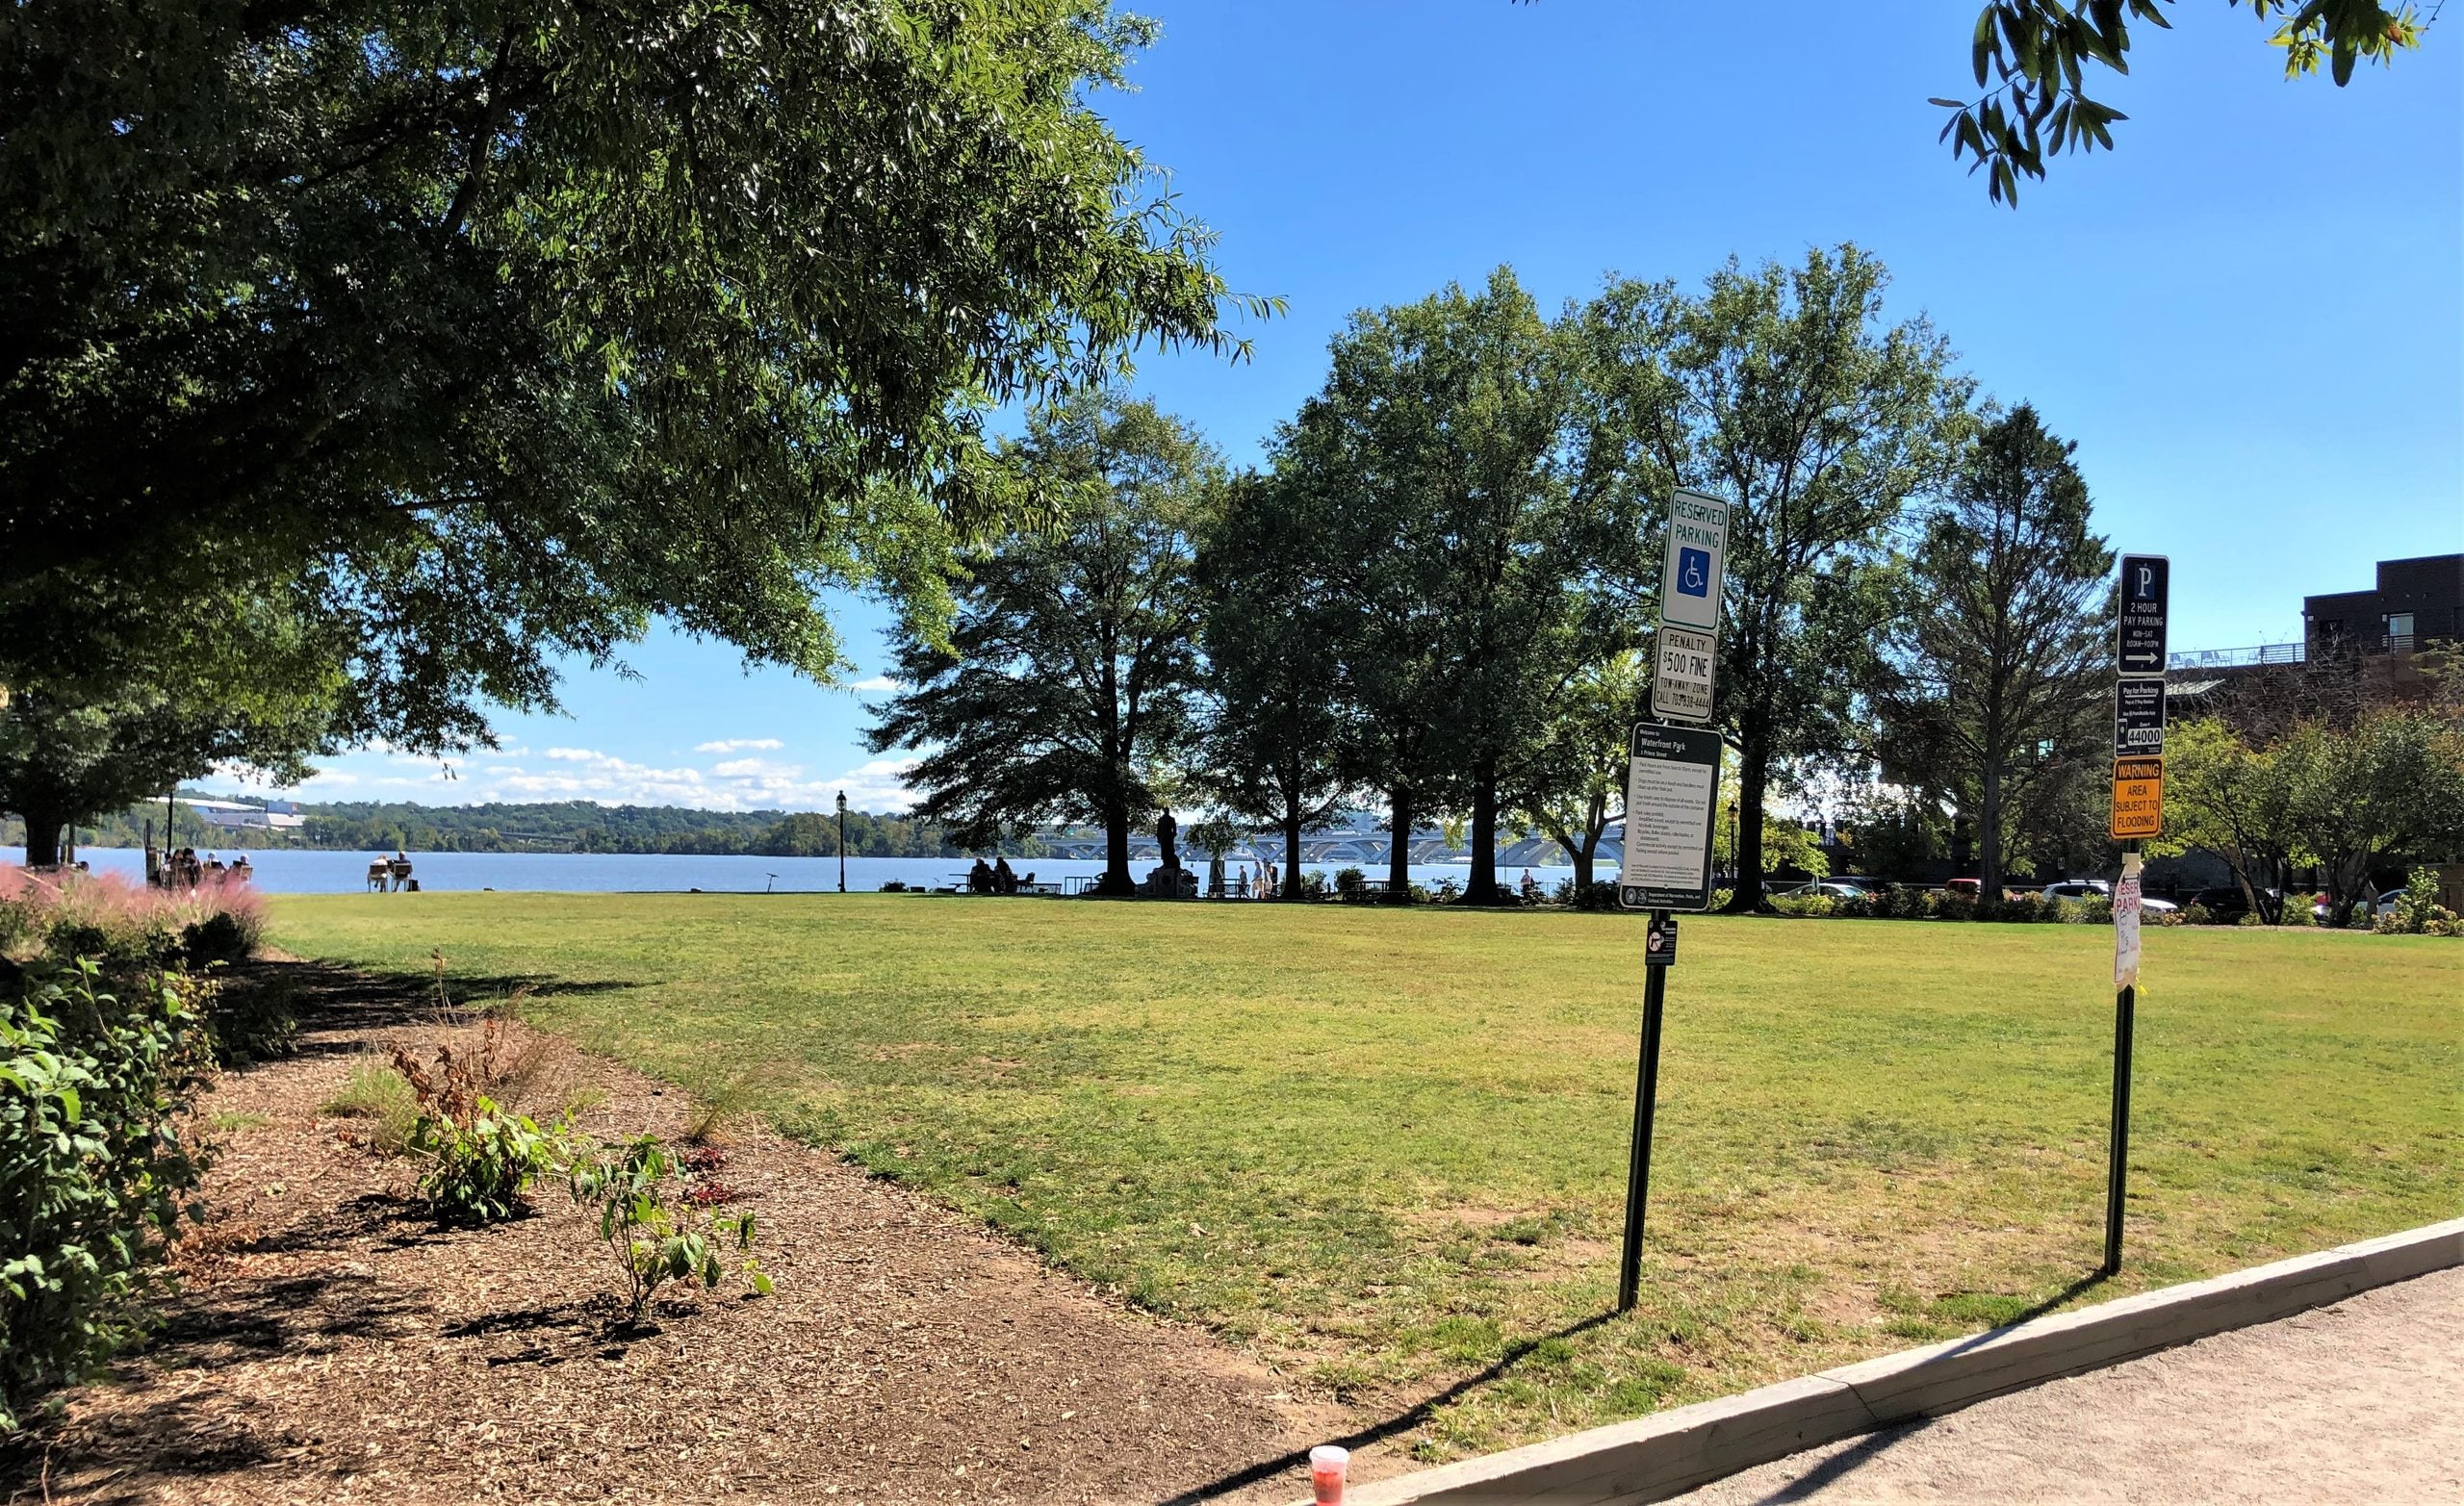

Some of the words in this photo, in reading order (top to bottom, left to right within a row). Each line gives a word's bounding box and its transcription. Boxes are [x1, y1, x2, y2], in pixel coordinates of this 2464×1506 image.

[1675, 500, 1724, 525] RESERVED
[1676, 523, 1719, 548] PARKING
[2139, 568, 2151, 597] P
[2131, 602, 2135, 612] 2
[2137, 602, 2157, 613] HOUR
[2123, 616, 2137, 625] PAY
[2138, 616, 2163, 626] PARKING
[1669, 634, 1706, 651] PENALTY
[1663, 651, 1686, 674] $500
[1689, 656, 1707, 677] FINE
[1661, 677, 1689, 691] TOW-AWAY
[1692, 683, 1707, 695] ZONE
[2123, 687, 2132, 696] Pay
[1656, 691, 1669, 703] CALL
[2129, 729, 2160, 743] 44000
[1642, 737, 1671, 749] Waterfront
[1673, 742, 1686, 751] Park
[2118, 764, 2159, 778] WARNING
[2127, 785, 2147, 796] AREA
[2117, 801, 2148, 812] SUBJECT
[2149, 800, 2157, 810] TO
[2118, 816, 2154, 828] FLOODING
